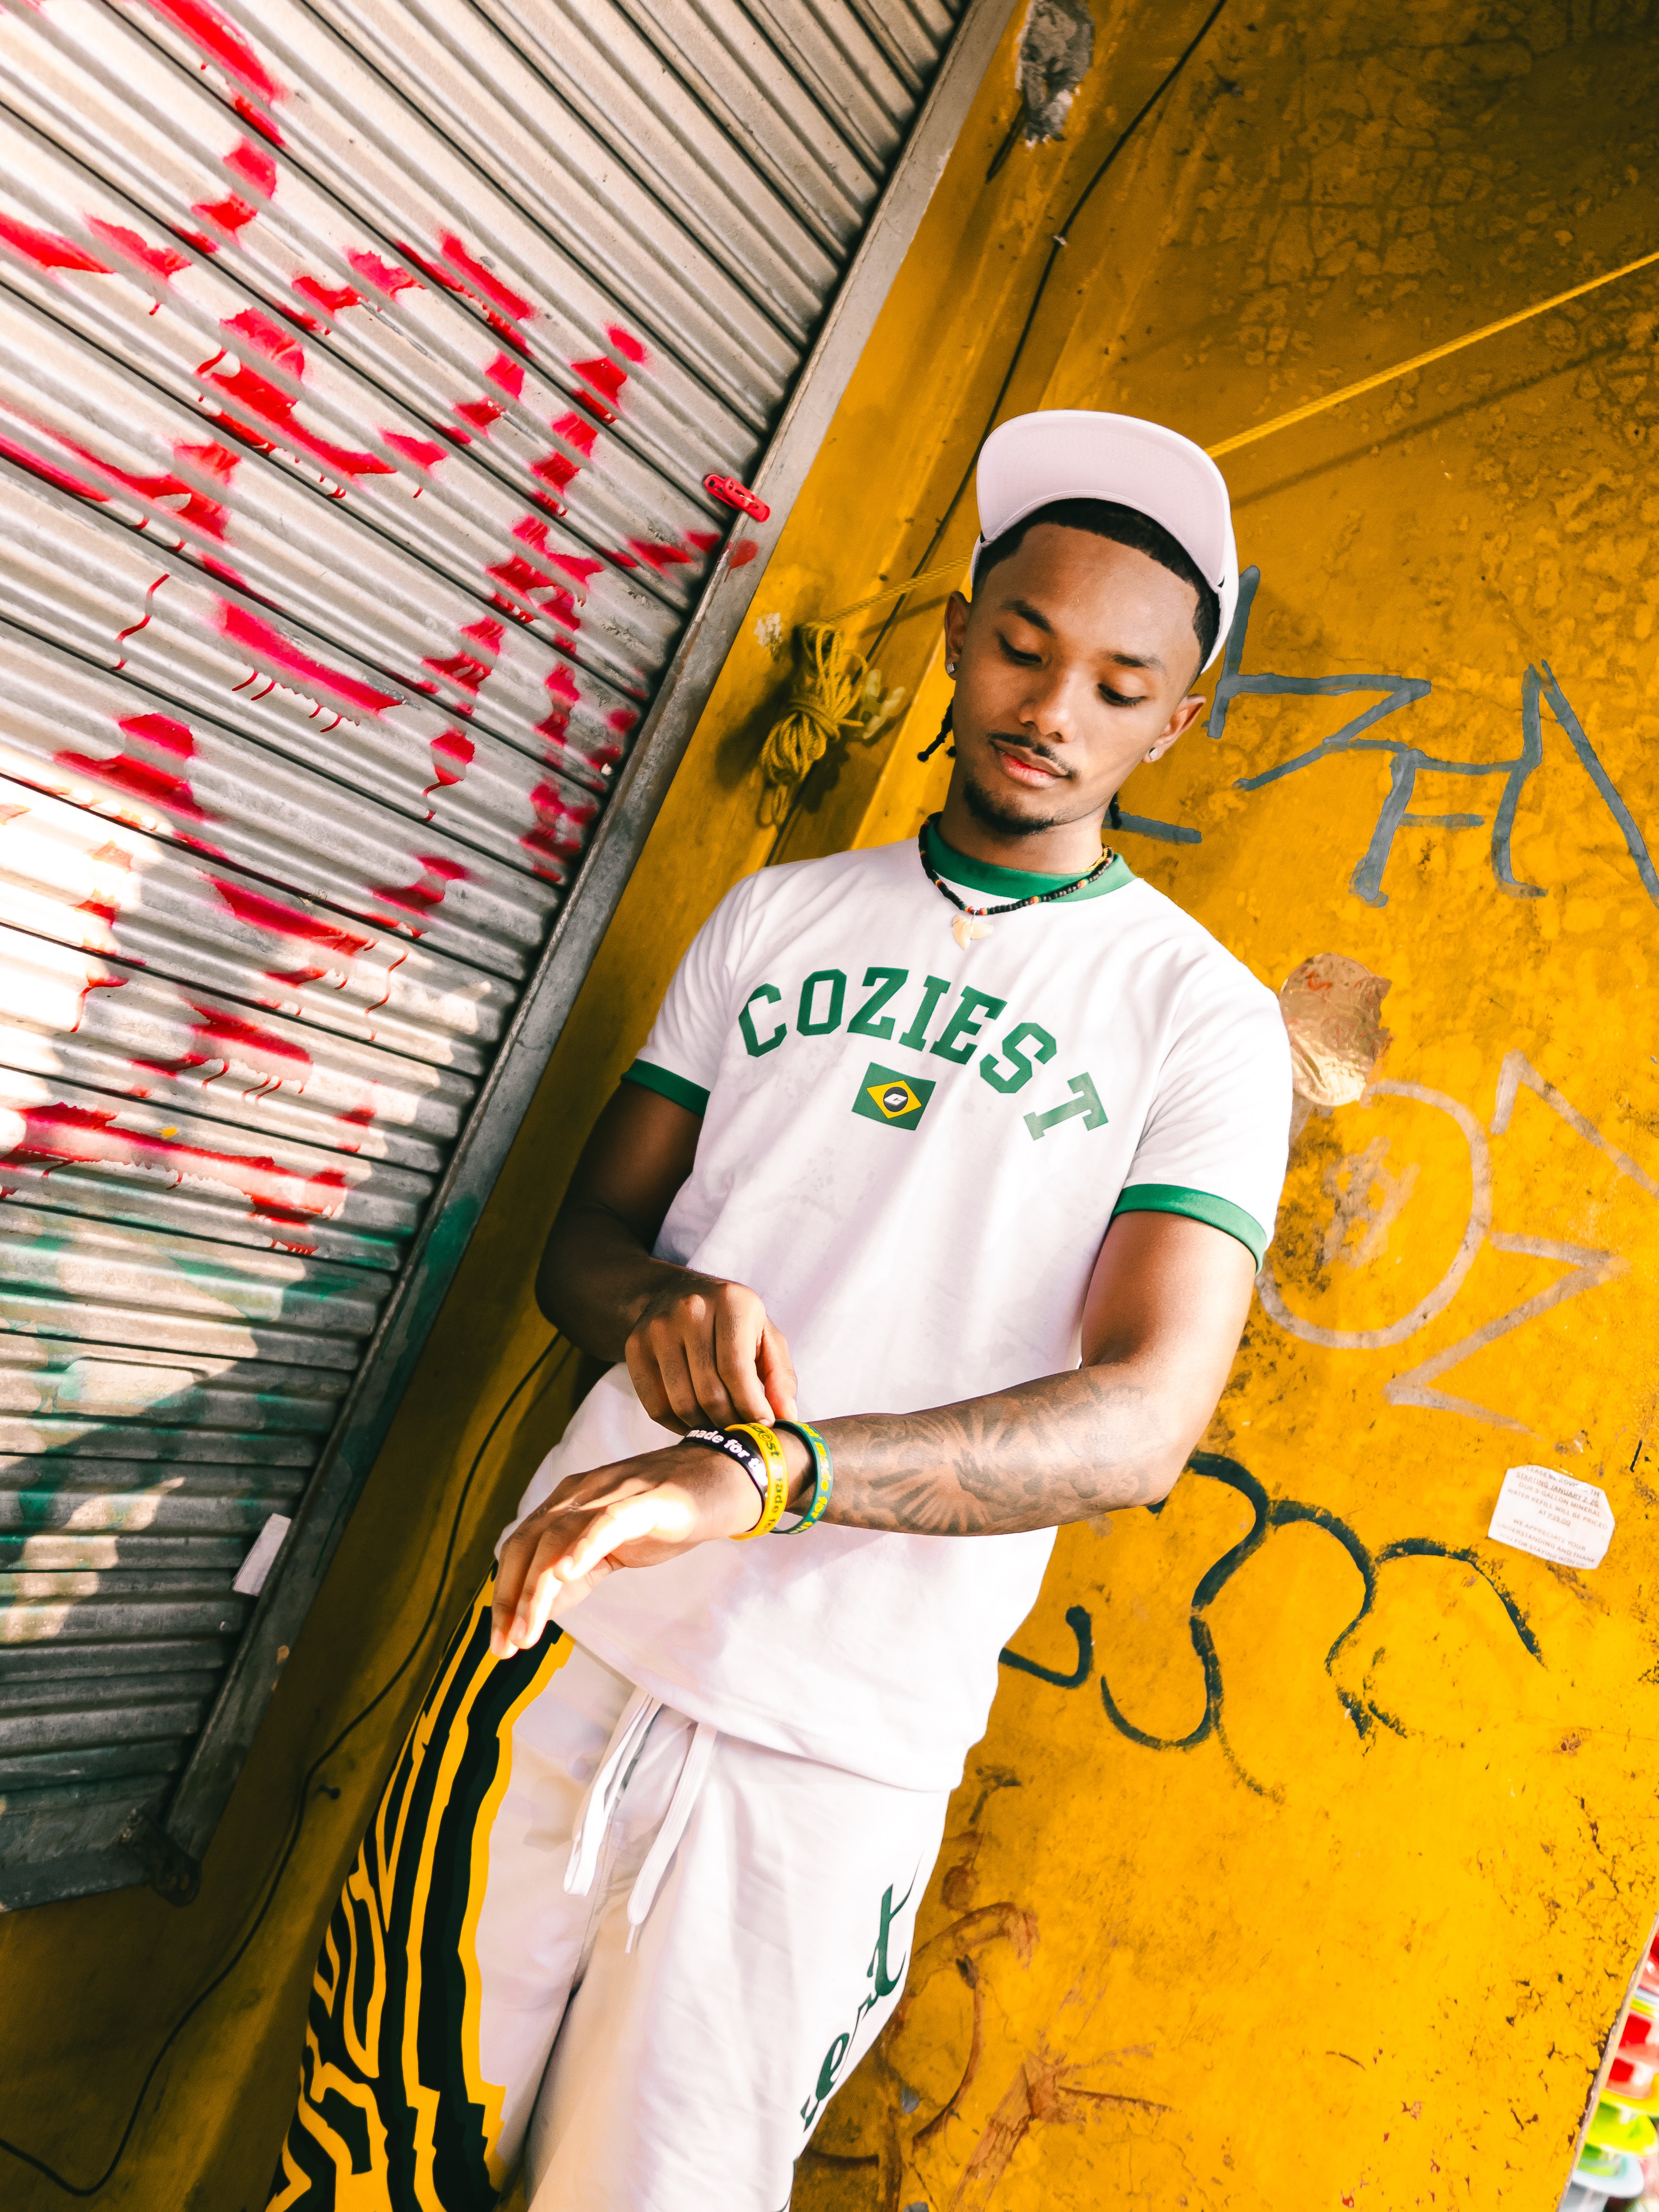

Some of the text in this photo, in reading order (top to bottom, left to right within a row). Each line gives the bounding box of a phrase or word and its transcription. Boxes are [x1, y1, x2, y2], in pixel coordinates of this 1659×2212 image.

[738, 967, 1109, 1141] COZIEST
[686, 1430, 724, 1443] made
[1516, 1471, 1549, 1488] STARTING
[1550, 1484, 1582, 1501] JANUARY
[1521, 1463, 1548, 1478] LEASE
[1507, 1488, 1530, 1500] WATER
[1531, 1497, 1554, 1509] REFILL
[1554, 1506, 1571, 1516] WILL
[1582, 1516, 1608, 1530] PRICED
[1518, 1481, 1534, 1492] OUR
[1570, 1502, 1601, 1517] MINERAL
[1497, 1522, 1595, 1564] UNDERSTANDING AND THANK
[1499, 1532, 1513, 1542] YOU
[1514, 1538, 1528, 1547] FOR
[1528, 1544, 1558, 1559] STAYING
[1513, 1518, 1586, 1551] WE APPRECIATE YOUR
